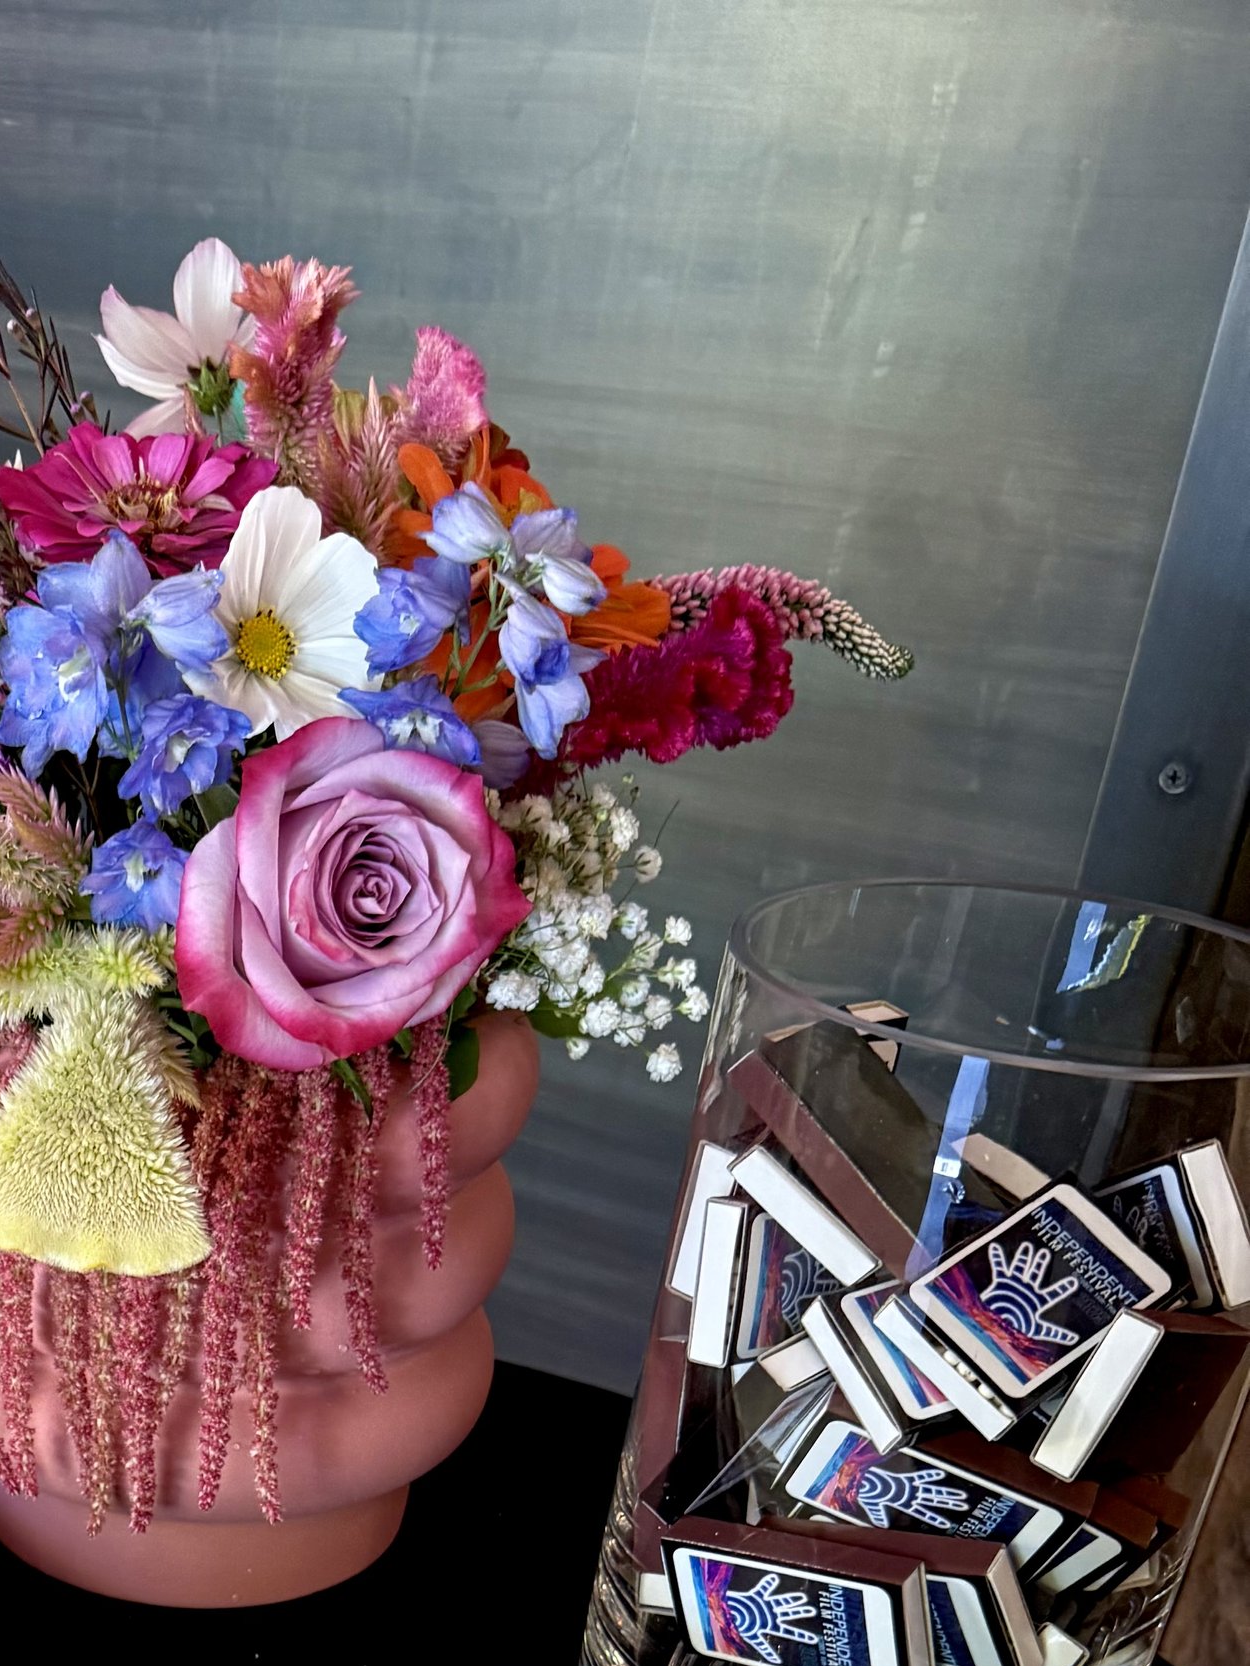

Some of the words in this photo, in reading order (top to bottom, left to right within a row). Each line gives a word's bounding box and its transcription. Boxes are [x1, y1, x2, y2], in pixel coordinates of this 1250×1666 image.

[1031, 1206, 1139, 1306] INDEPENDENT
[1031, 1222, 1064, 1252] FILM
[1063, 1251, 1121, 1306] FESTIVAL
[972, 1496, 996, 1518] FILM
[818, 1590, 832, 1620] FILM
